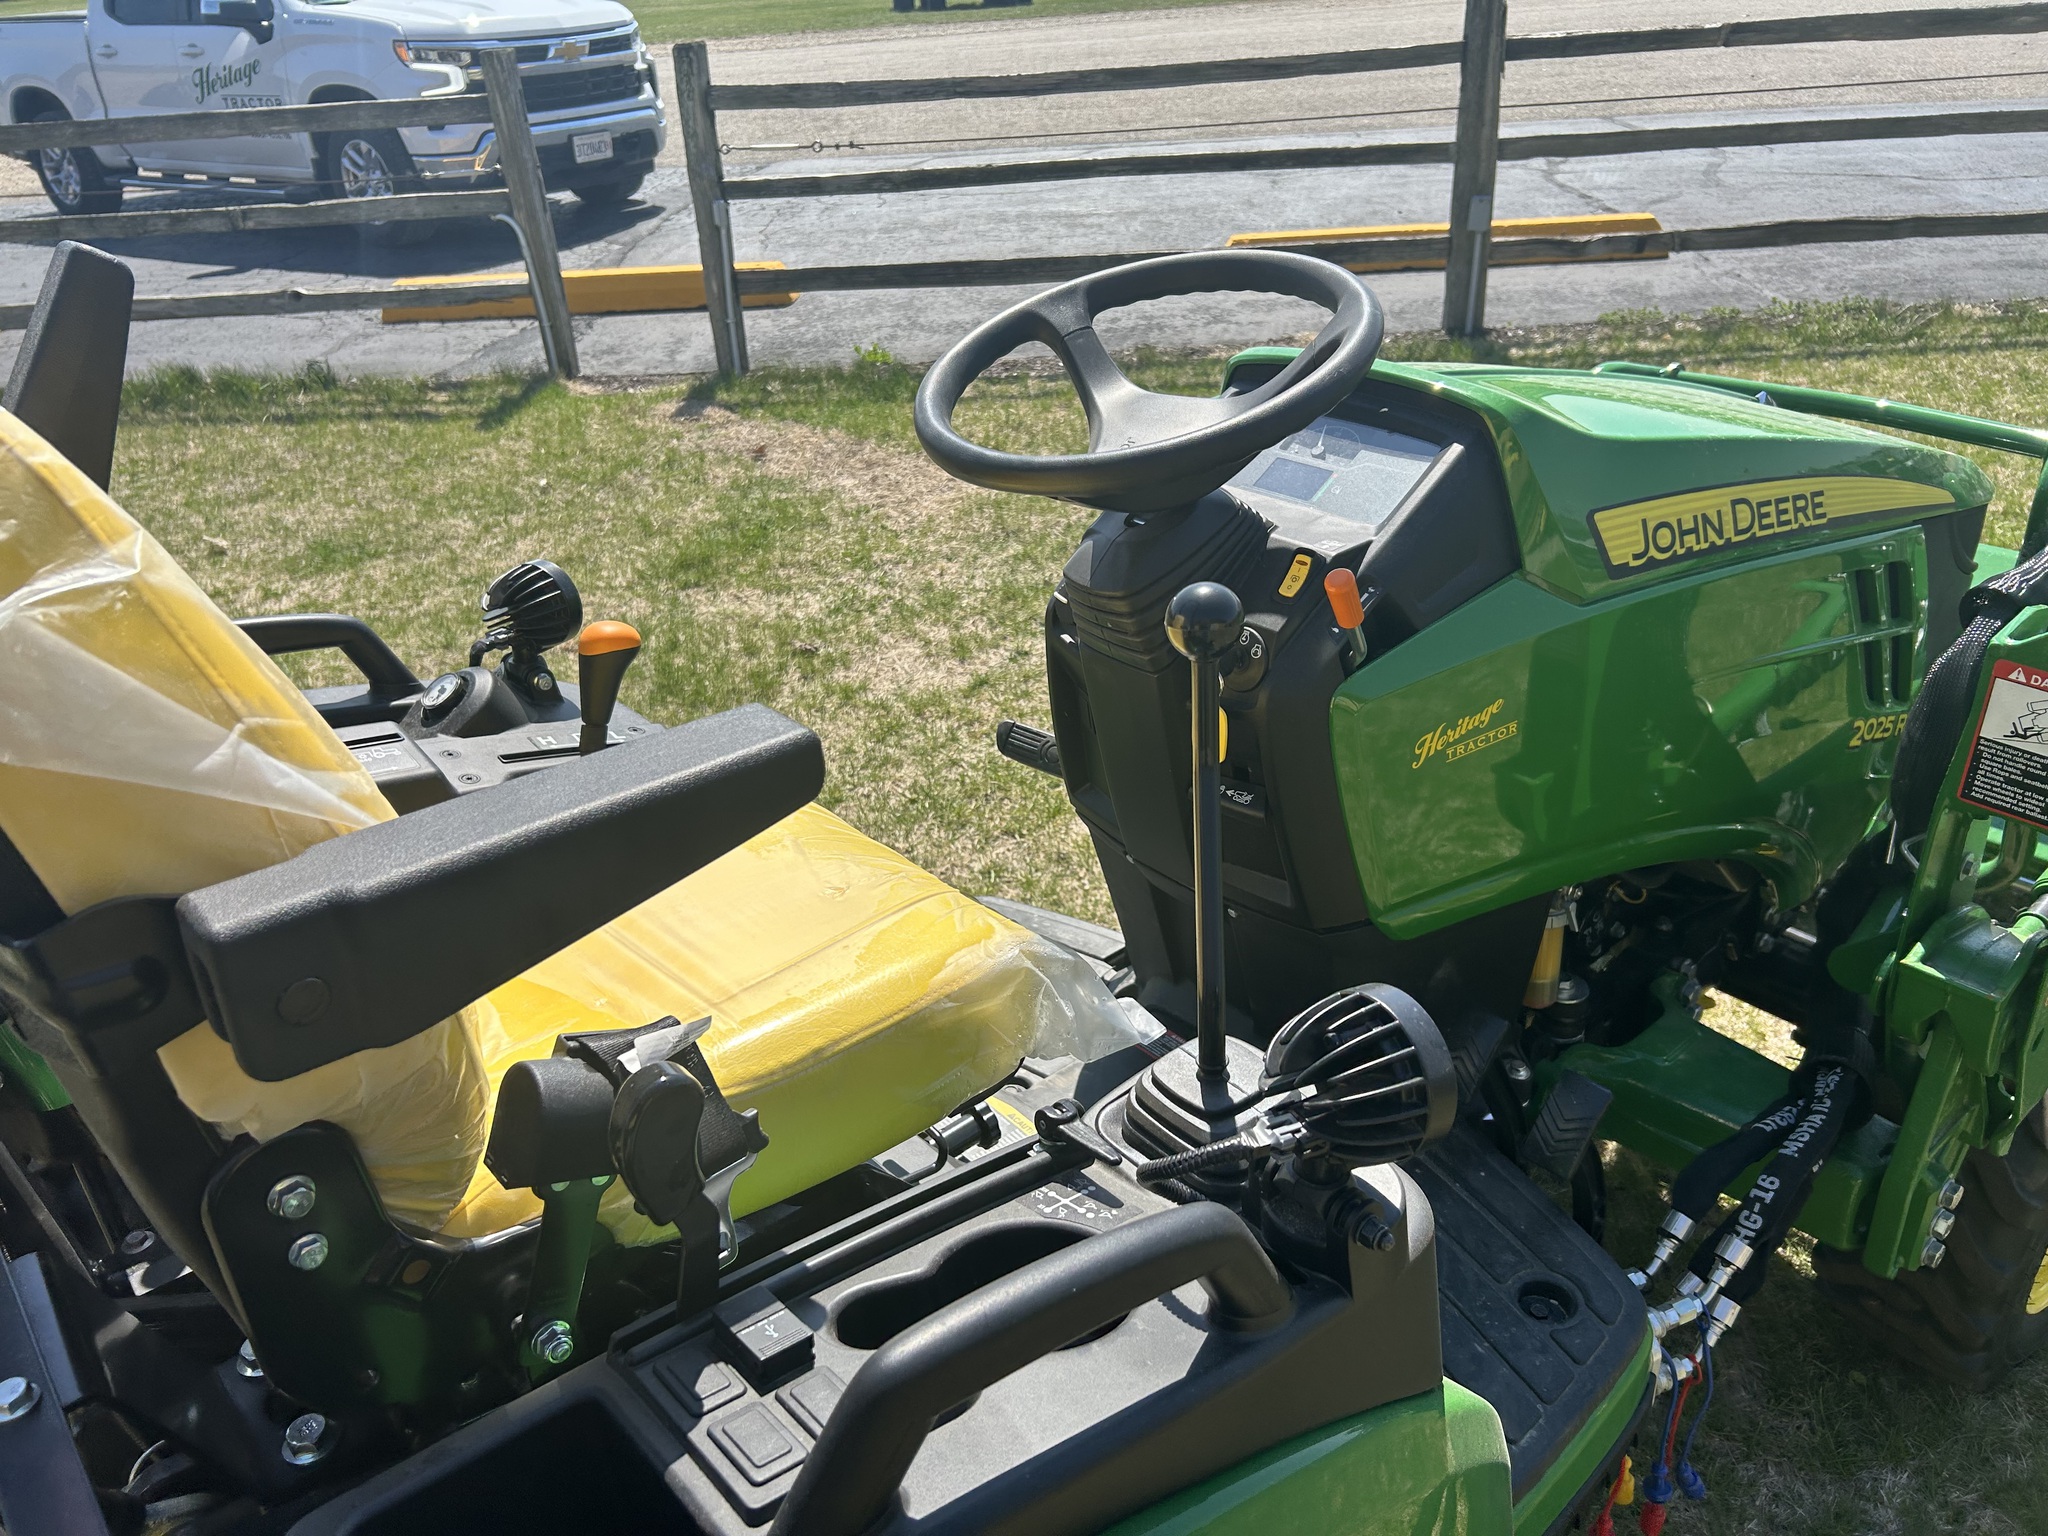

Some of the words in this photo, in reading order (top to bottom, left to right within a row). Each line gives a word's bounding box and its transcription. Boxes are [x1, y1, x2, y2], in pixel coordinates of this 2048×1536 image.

[192, 58, 261, 104] Heritage
[221, 97, 283, 110] TRACTOR
[1631, 509, 1726, 562] JOHN
[1729, 489, 1828, 538] DEERE
[1411, 698, 1505, 769] Heritage
[1446, 722, 1518, 760] TRACTOR
[1978, 746, 1996, 754] result
[1997, 751, 2012, 759] from
[2013, 756, 2042, 769] rollovers.
[1980, 739, 2004, 750] Serious
[2005, 746, 2022, 756] injury
[1981, 758, 2002, 768] square
[2003, 764, 2022, 775] bales.
[1986, 772, 2005, 782] times.
[1993, 767, 2009, 777] Rops
[2004, 759, 2026, 769] handle
[2027, 766, 2047, 776] round
[1974, 780, 1991, 789] Move
[1992, 786, 2015, 797] wheels
[2024, 797, 2045, 807] widest
[1976, 774, 2001, 786] Operate
[2002, 782, 2024, 794] tractor
[1970, 791, 1984, 799] Add
[1984, 796, 2011, 808] required
[1972, 786, 2018, 804] recommended
[2018, 799, 2042, 813] setting.
[1732, 1174, 1781, 1244] HG-16
[1778, 1113, 1827, 1158] MSHA
